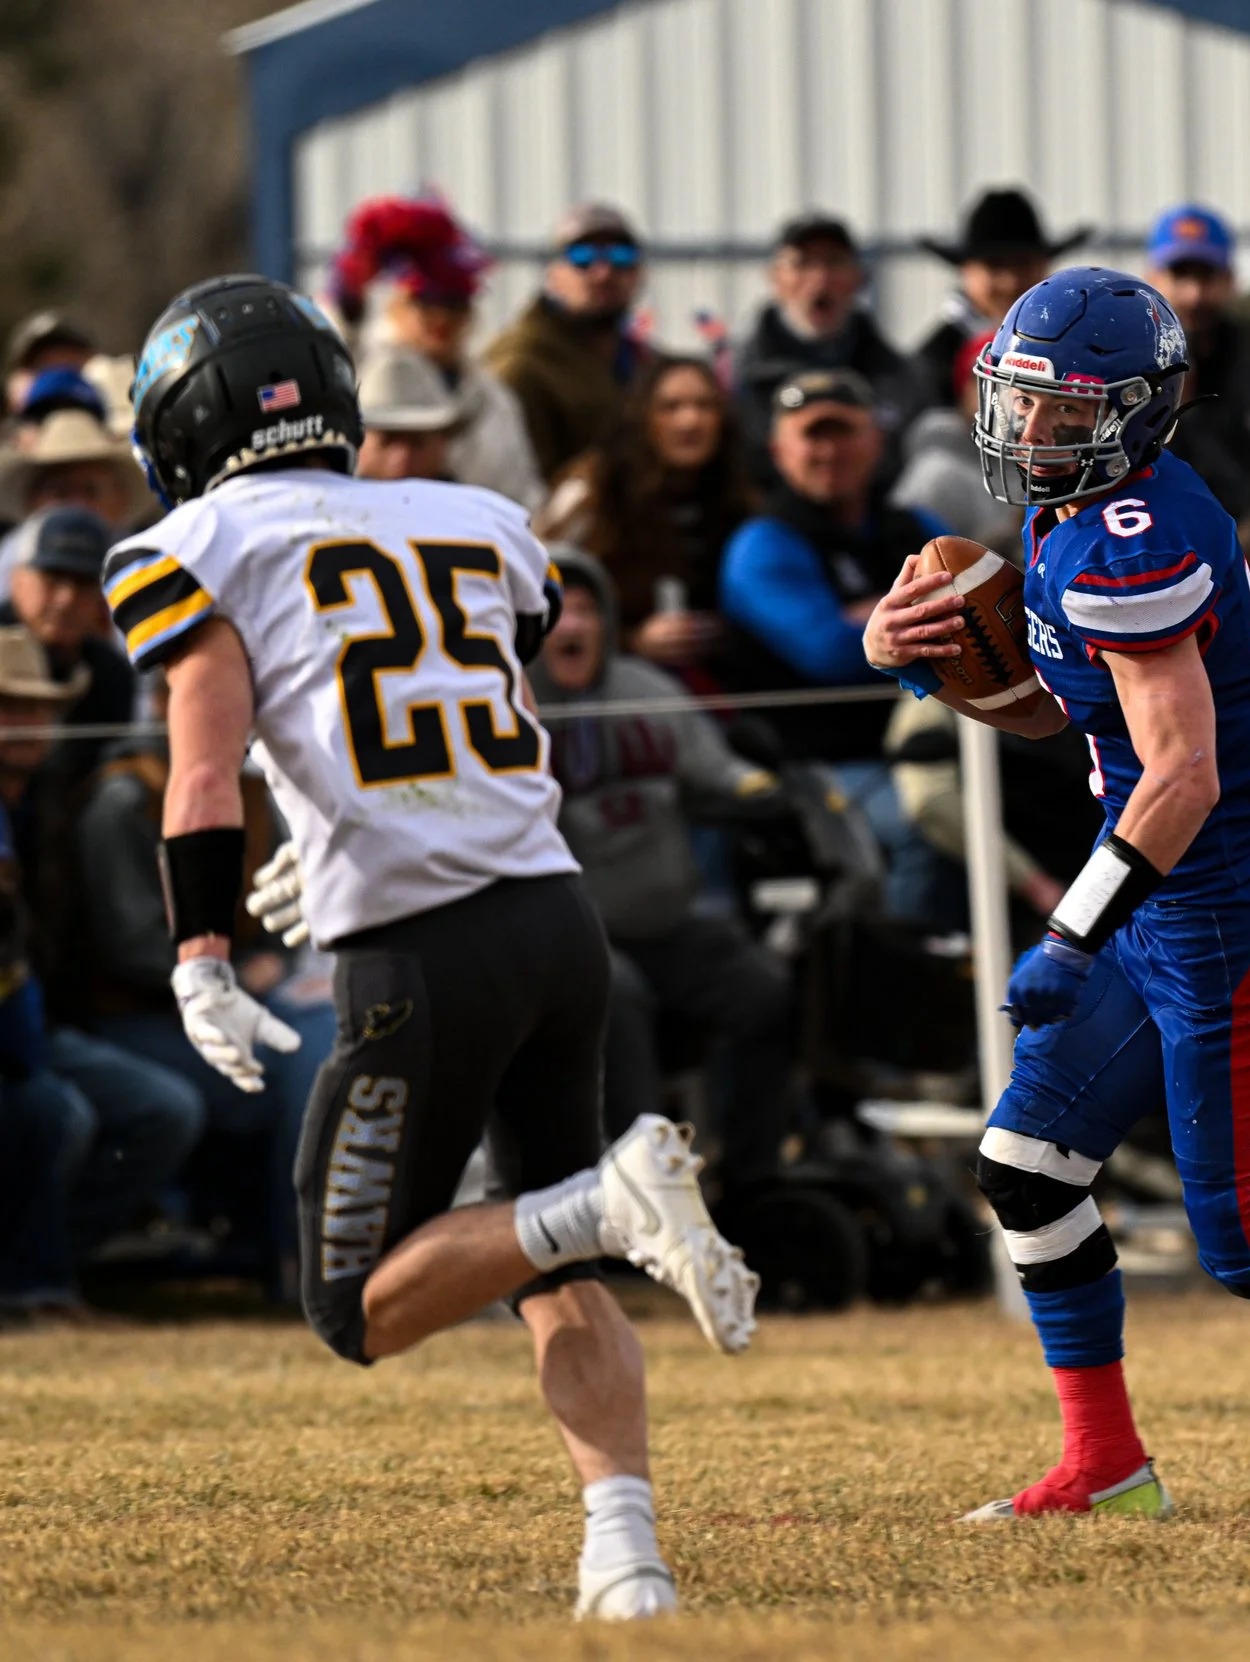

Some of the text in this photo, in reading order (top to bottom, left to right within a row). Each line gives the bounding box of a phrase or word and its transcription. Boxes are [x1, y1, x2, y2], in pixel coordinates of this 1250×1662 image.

[251, 413, 325, 449] schutt
[1101, 498, 1154, 539] 6
[303, 538, 542, 790] 25
[321, 1074, 408, 1282] HAWKS
